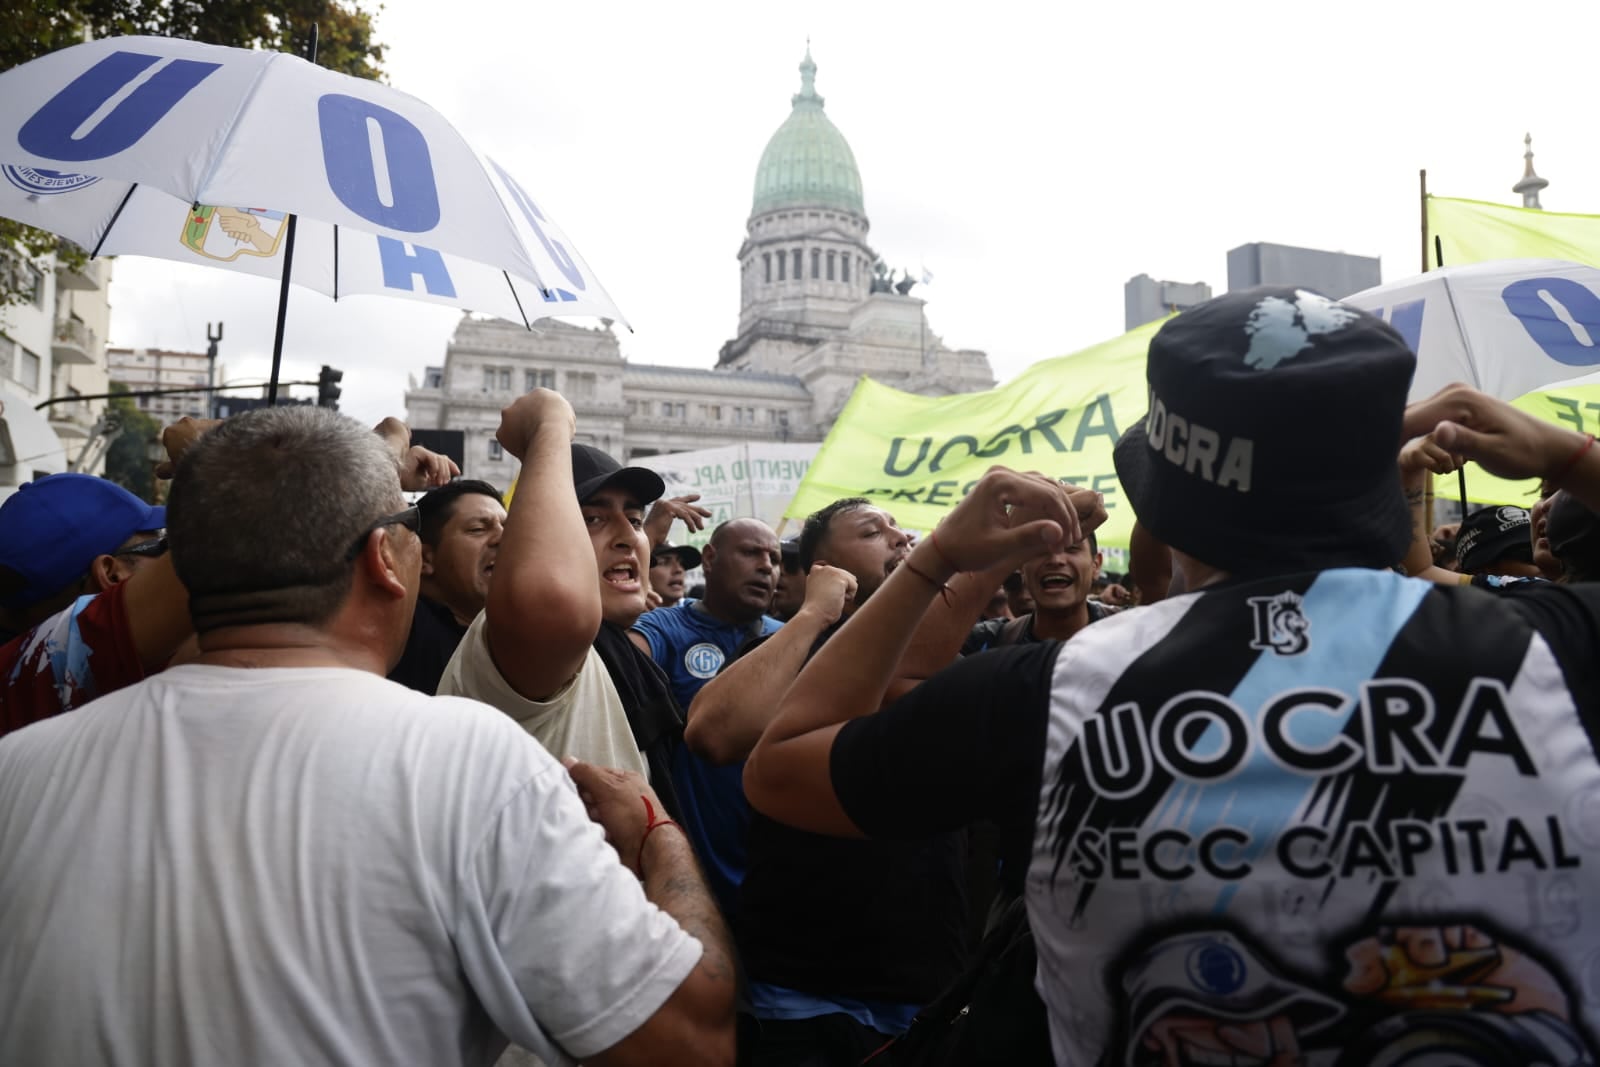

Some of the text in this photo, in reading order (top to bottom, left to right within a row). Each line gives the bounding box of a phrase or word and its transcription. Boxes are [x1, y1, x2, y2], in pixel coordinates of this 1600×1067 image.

[1081, 678, 1538, 798] UOCRA
[1075, 815, 1581, 882] SECC CAPITAL
